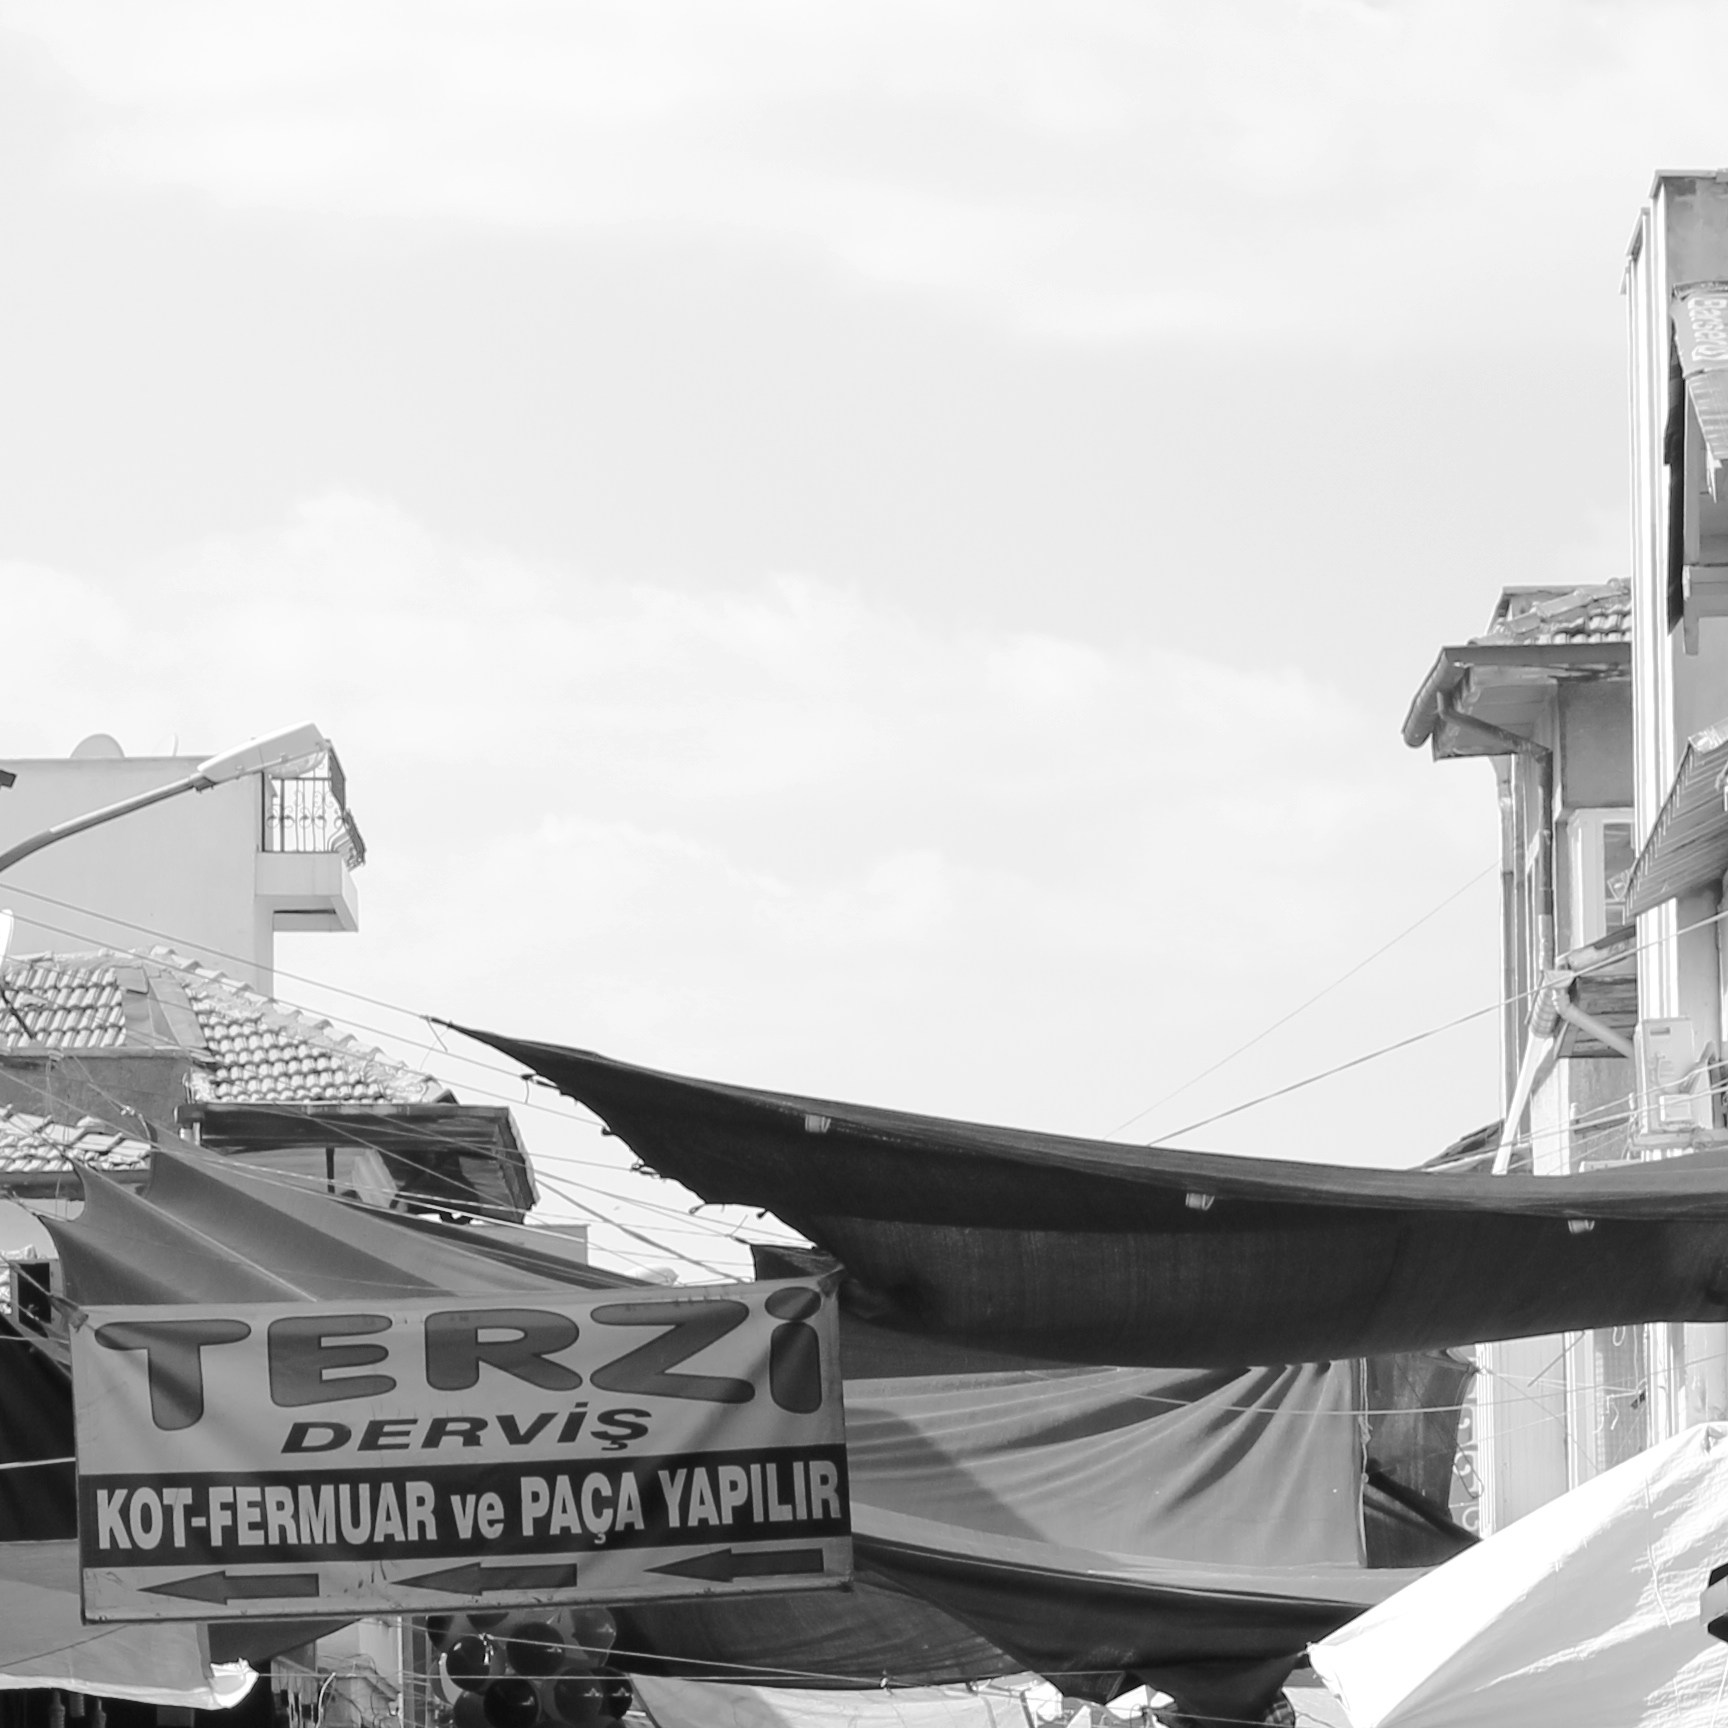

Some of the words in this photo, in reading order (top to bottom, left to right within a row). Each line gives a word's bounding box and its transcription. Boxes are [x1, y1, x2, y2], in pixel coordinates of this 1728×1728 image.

[94, 1286, 824, 1432] TERZİ
[281, 1401, 653, 1454] DERVİŞ
[96, 1477, 437, 1551] KOT-FERMUAR
[451, 1493, 503, 1540] ve
[521, 1470, 645, 1545] PAÇA
[659, 1459, 841, 1527] YAPILIR
